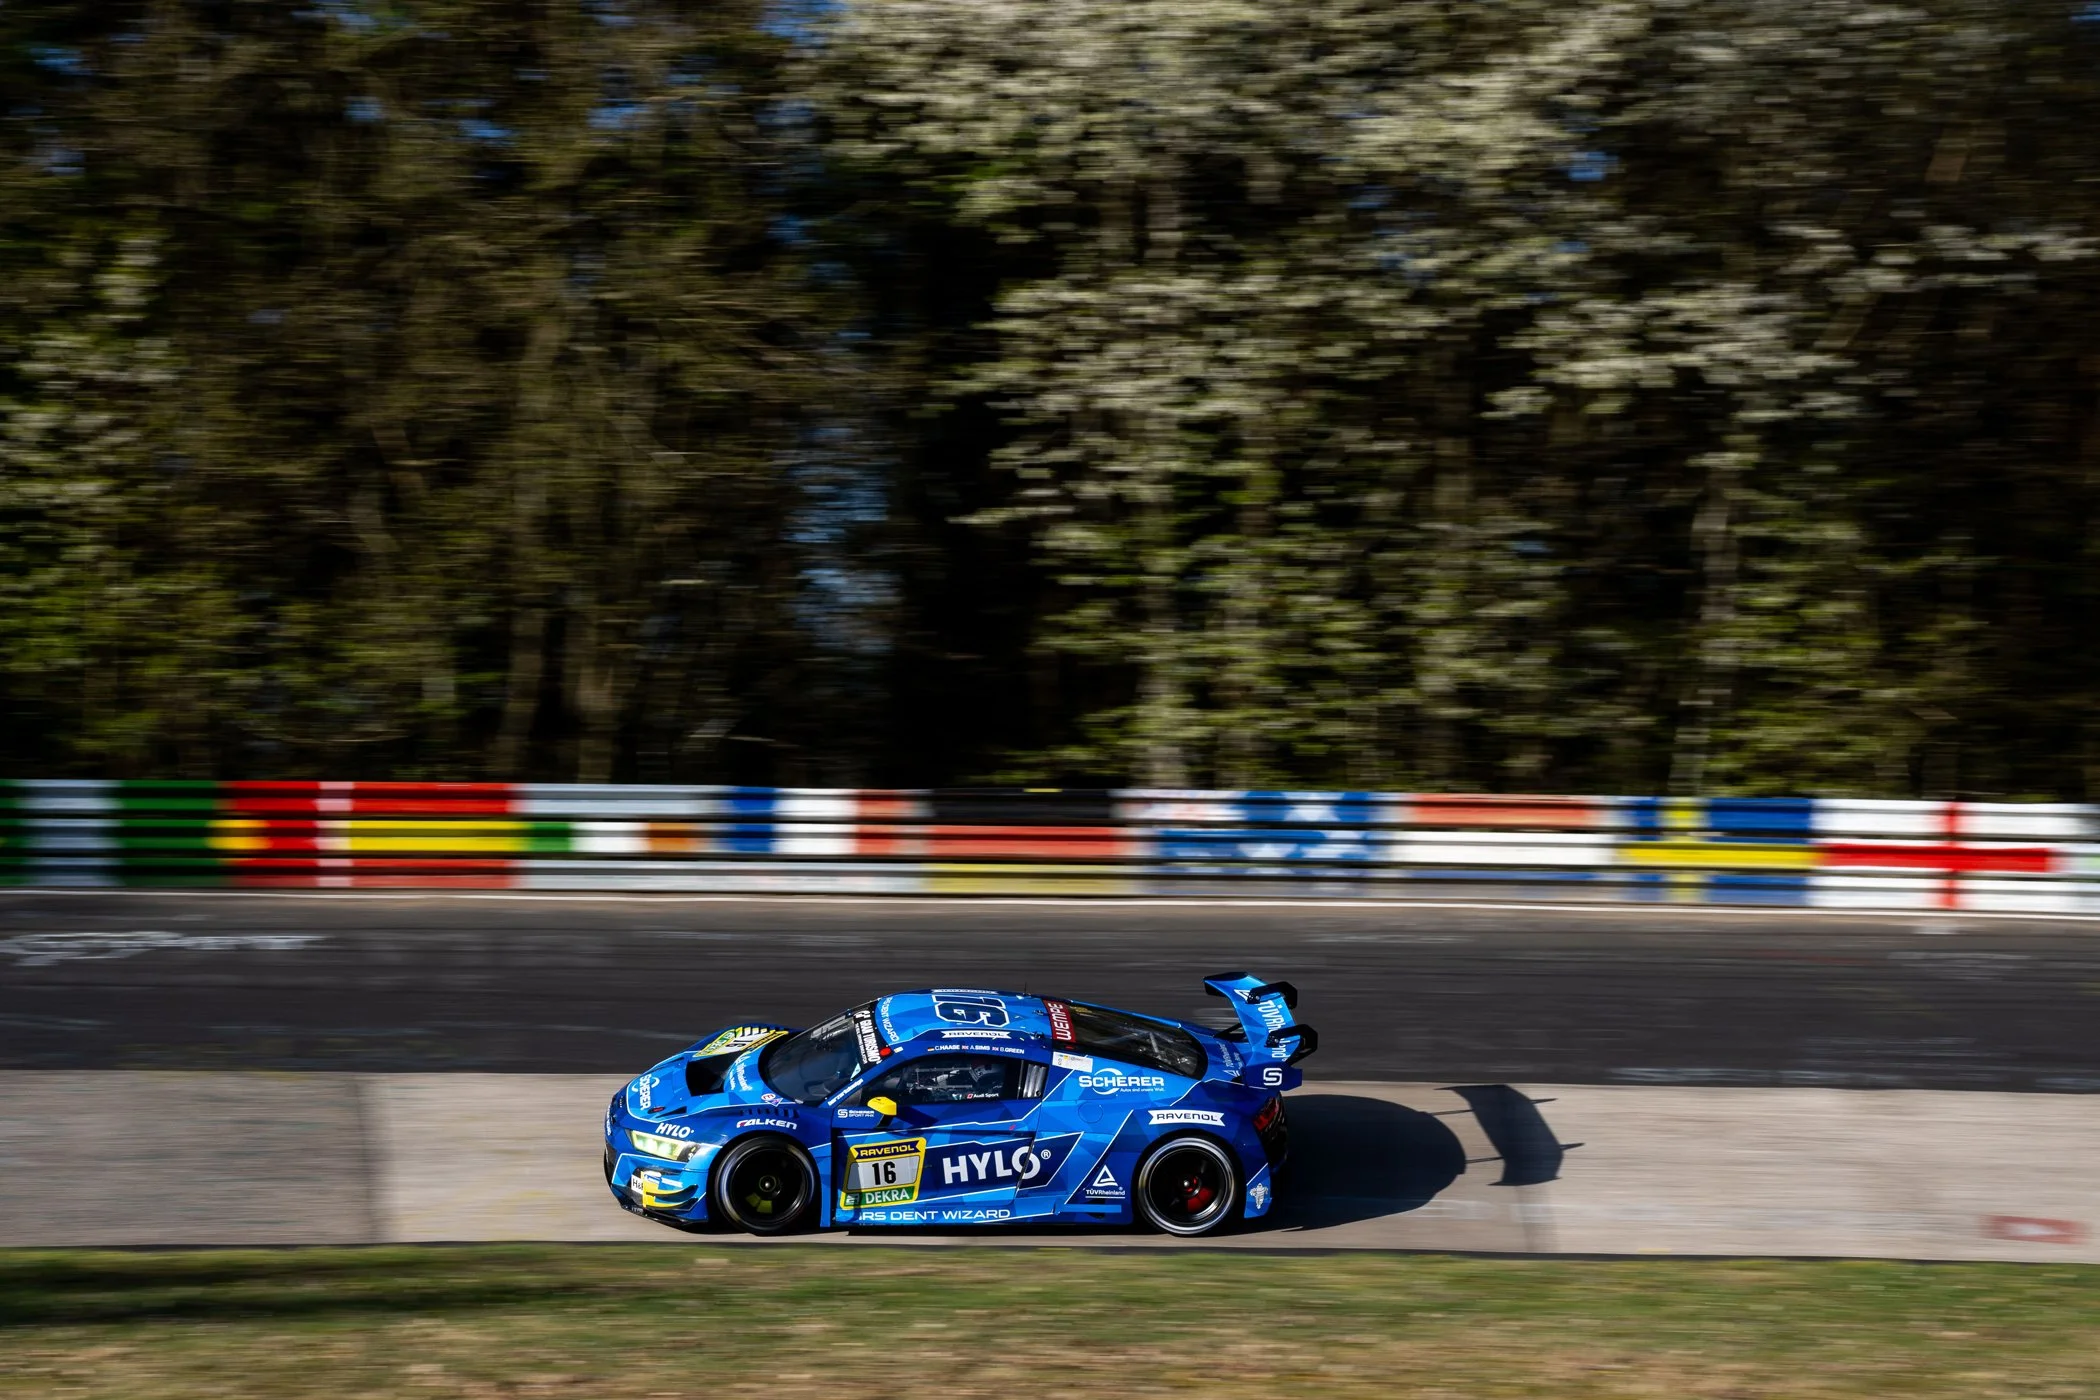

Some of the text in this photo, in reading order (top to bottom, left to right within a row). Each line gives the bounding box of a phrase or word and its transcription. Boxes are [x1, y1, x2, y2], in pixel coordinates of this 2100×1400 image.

[1048, 1003, 1072, 1041] WEMPE
[860, 1019, 881, 1062] GRAN TURISMO
[1079, 1076, 1165, 1087] SCHERER
[639, 1073, 652, 1111] SCHERER
[736, 1118, 798, 1130] FALKEN
[1156, 1112, 1218, 1122] RAVENOL
[655, 1122, 691, 1138] HYLO
[860, 1144, 914, 1157] RAVENOL
[872, 1161, 896, 1185] 16
[865, 1188, 910, 1204] DEKRA
[890, 1211, 938, 1220] DENT
[942, 1209, 1011, 1220] WIZARD
